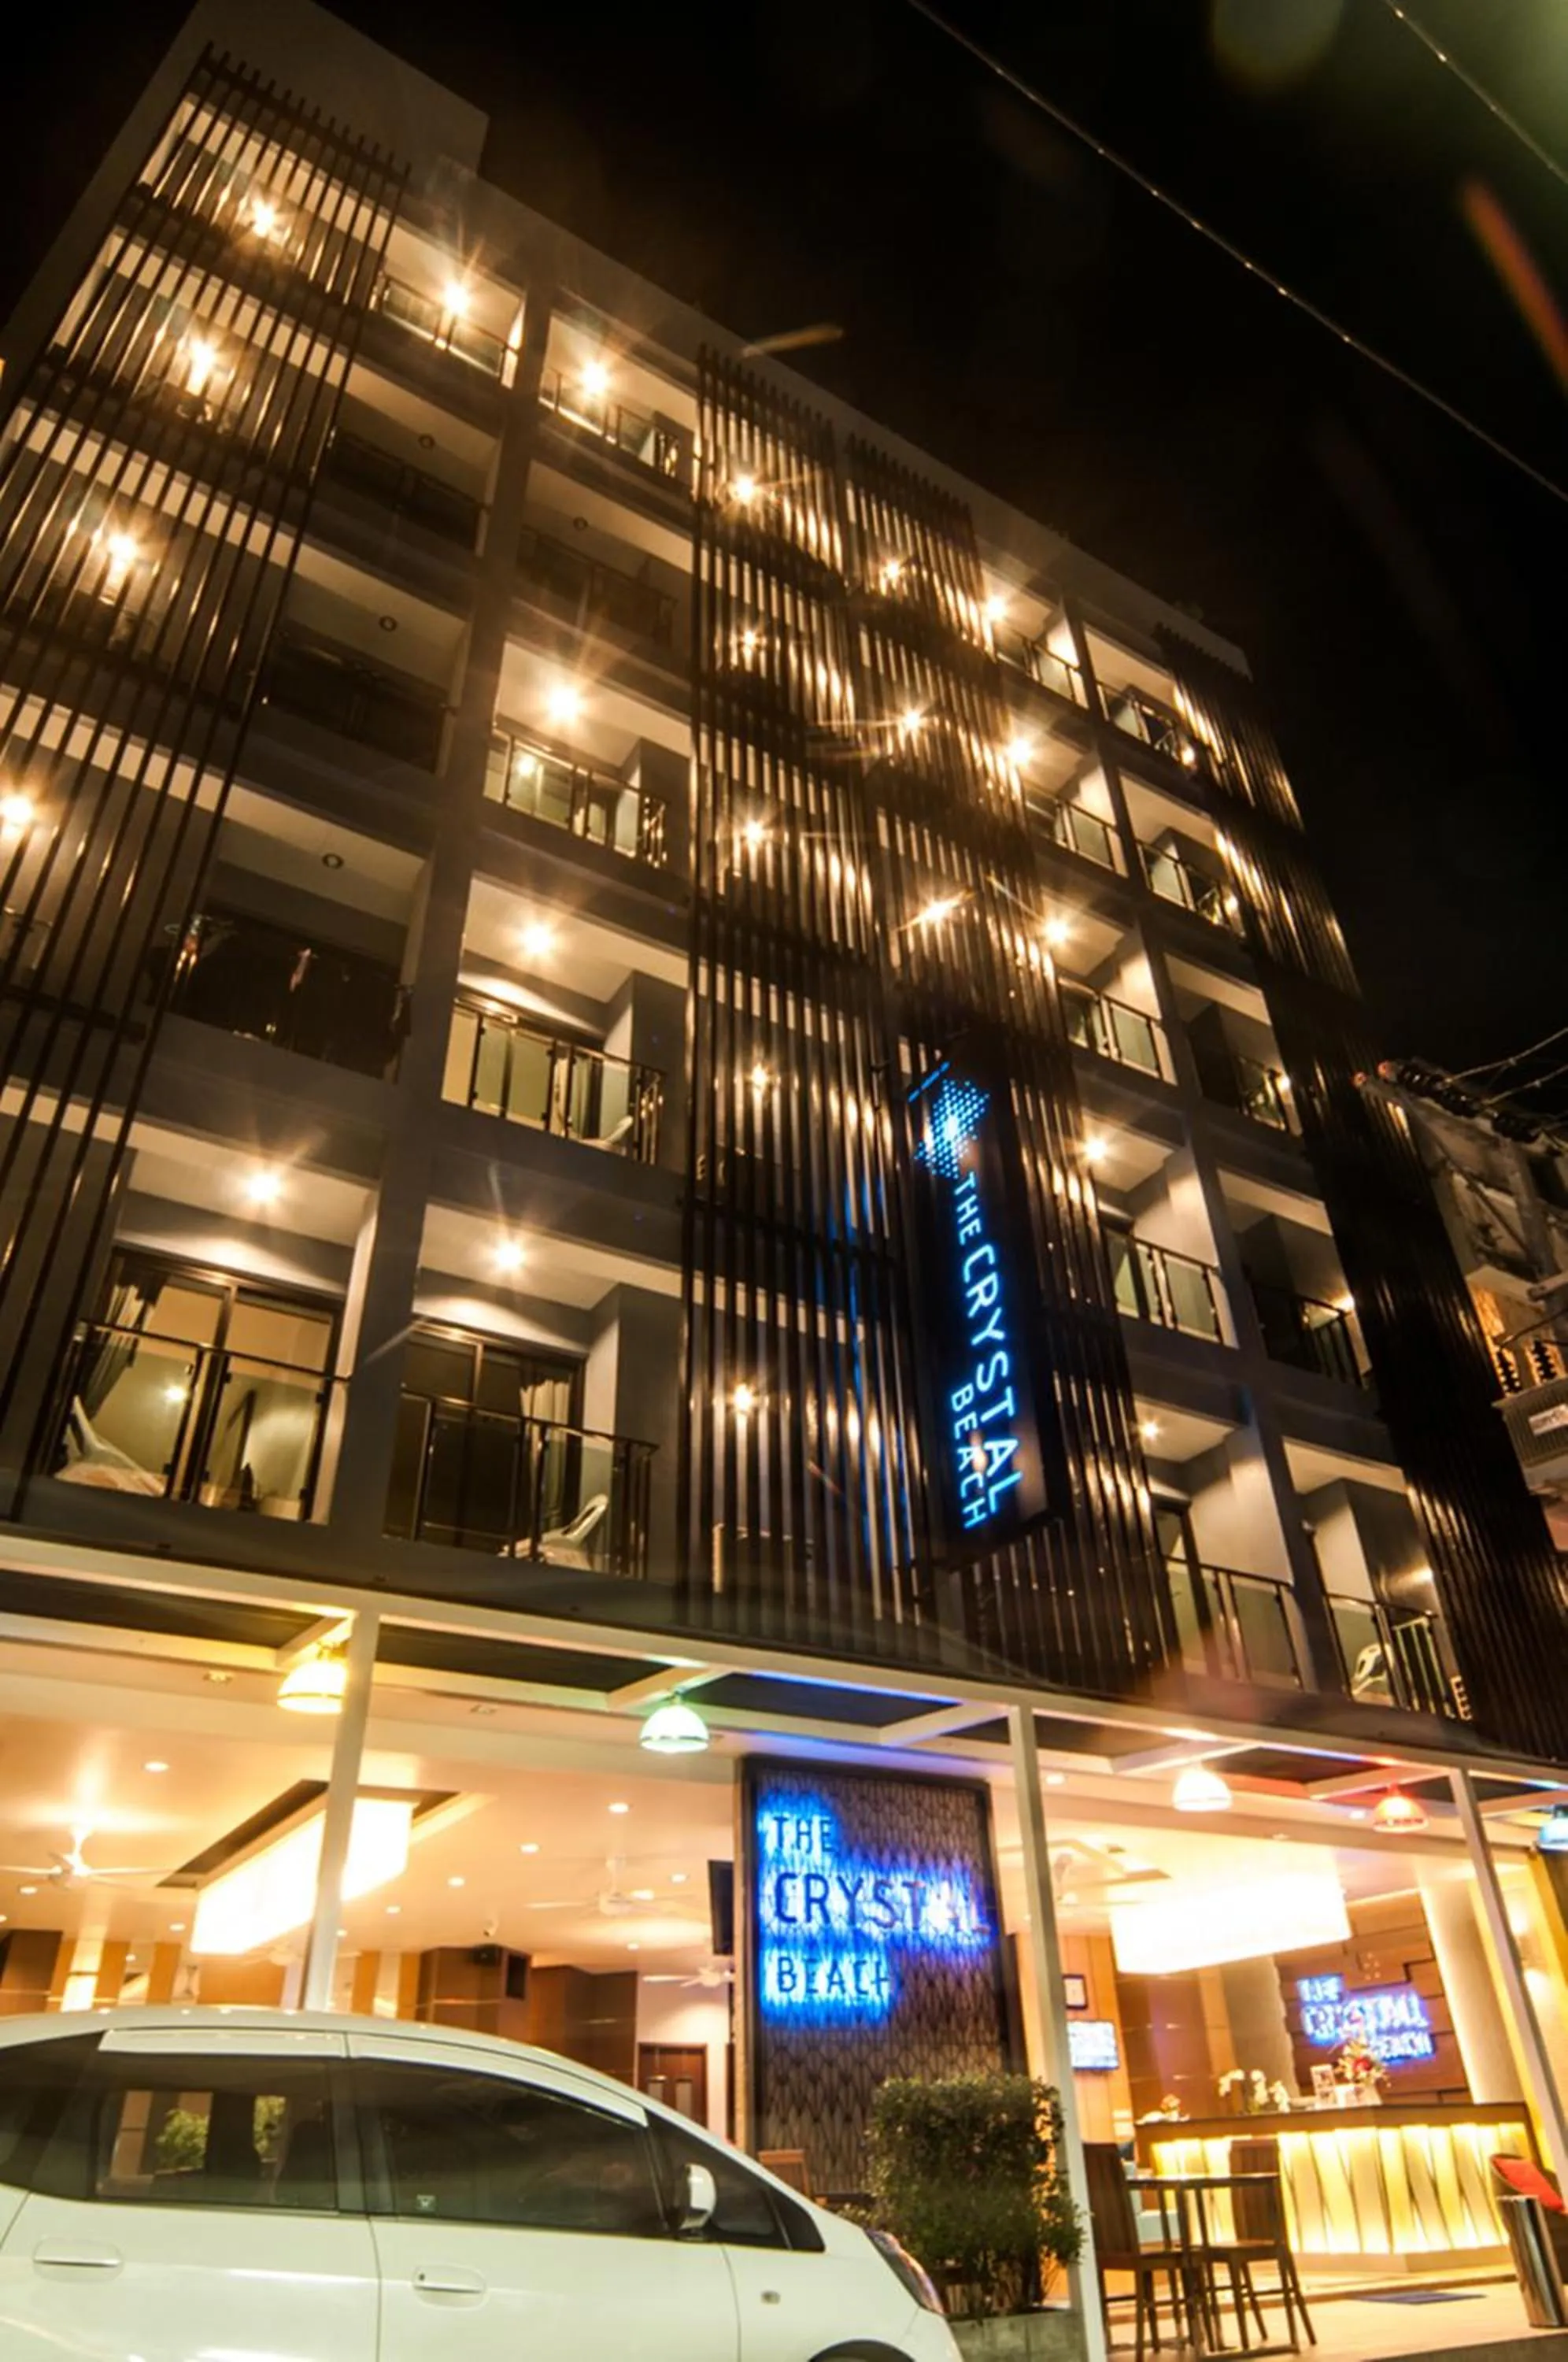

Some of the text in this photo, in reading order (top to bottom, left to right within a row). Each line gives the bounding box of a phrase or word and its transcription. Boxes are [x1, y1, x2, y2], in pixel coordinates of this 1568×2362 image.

[952, 1172, 982, 1246] THE
[962, 1243, 1023, 1514] CRYSTAL
[950, 1383, 987, 1529] BEACH
[773, 1814, 836, 1853] THE
[776, 1956, 894, 1996] BEACH
